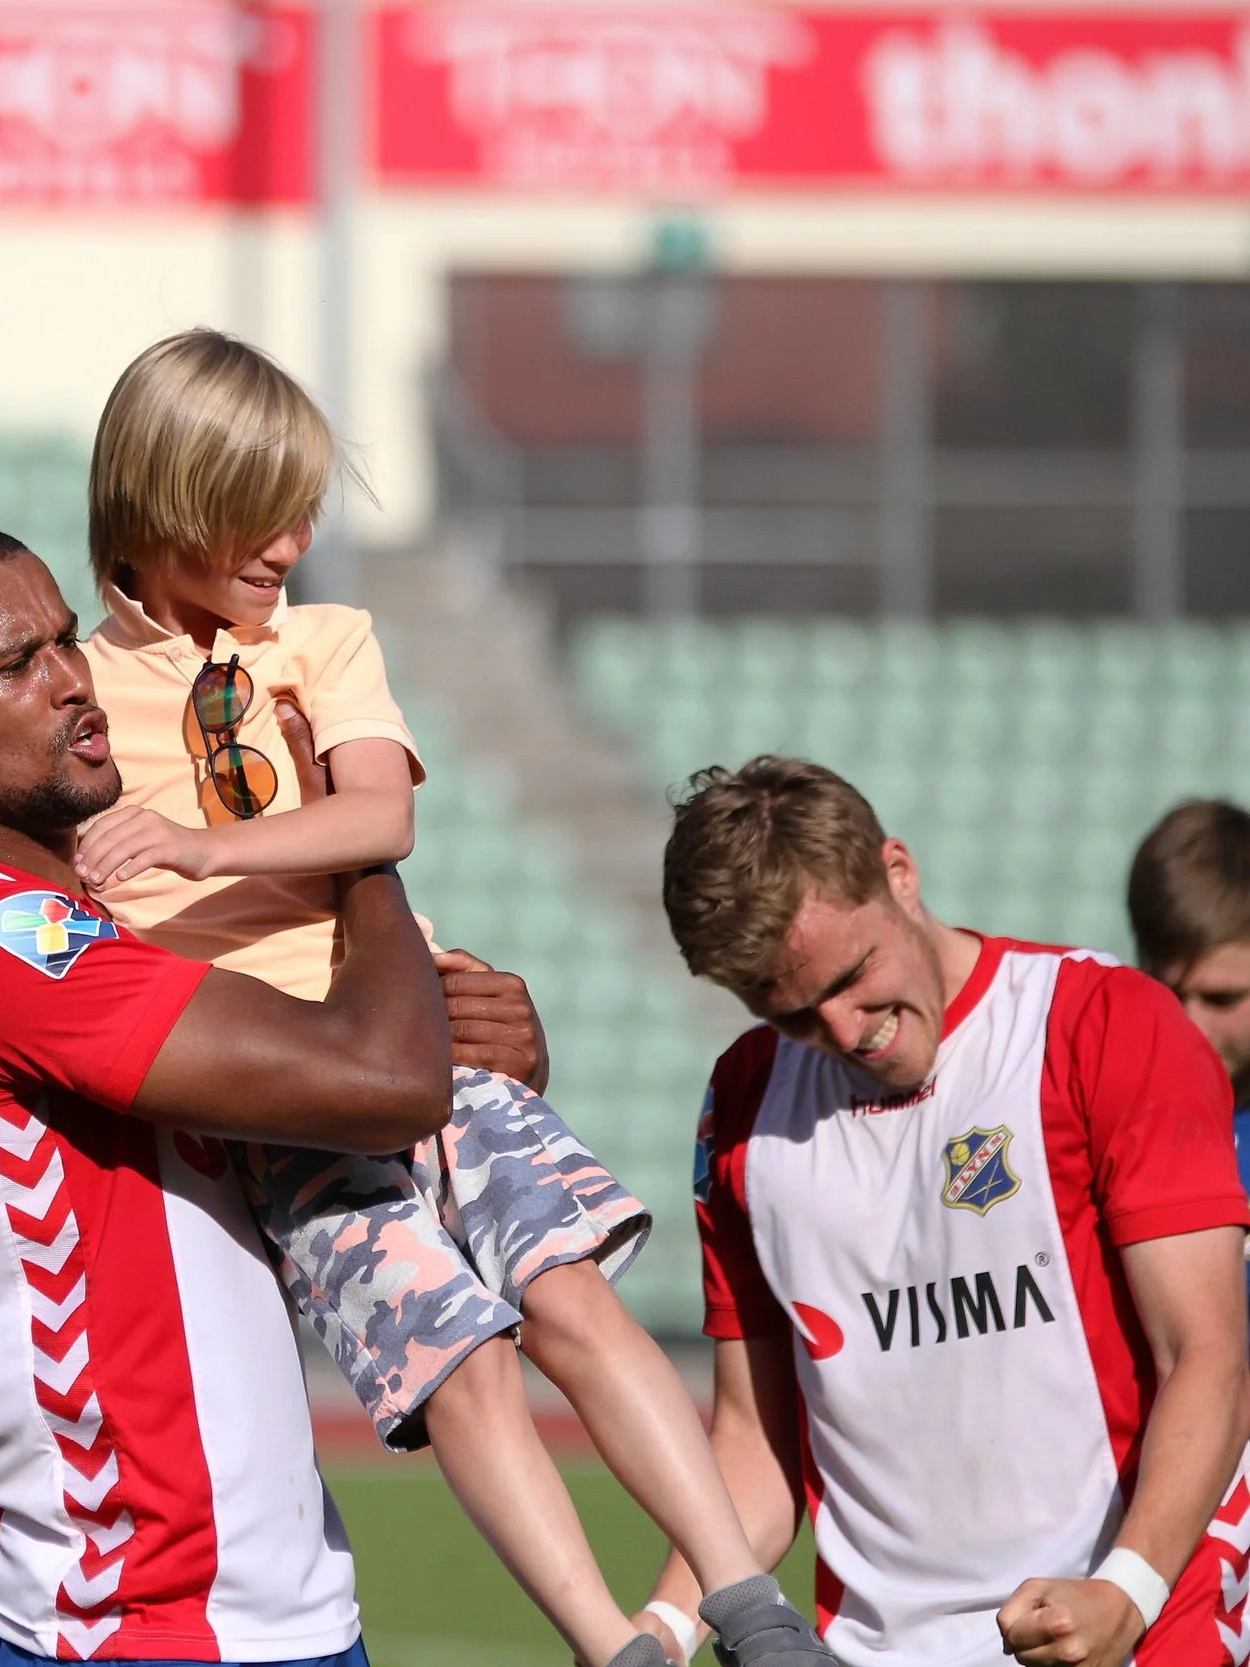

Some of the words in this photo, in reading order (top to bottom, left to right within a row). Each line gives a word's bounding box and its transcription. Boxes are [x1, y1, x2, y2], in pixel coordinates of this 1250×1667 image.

[864, 10, 1250, 184] thon
[960, 1147, 991, 1184] LYN
[861, 1264, 1055, 1352] VISMA
